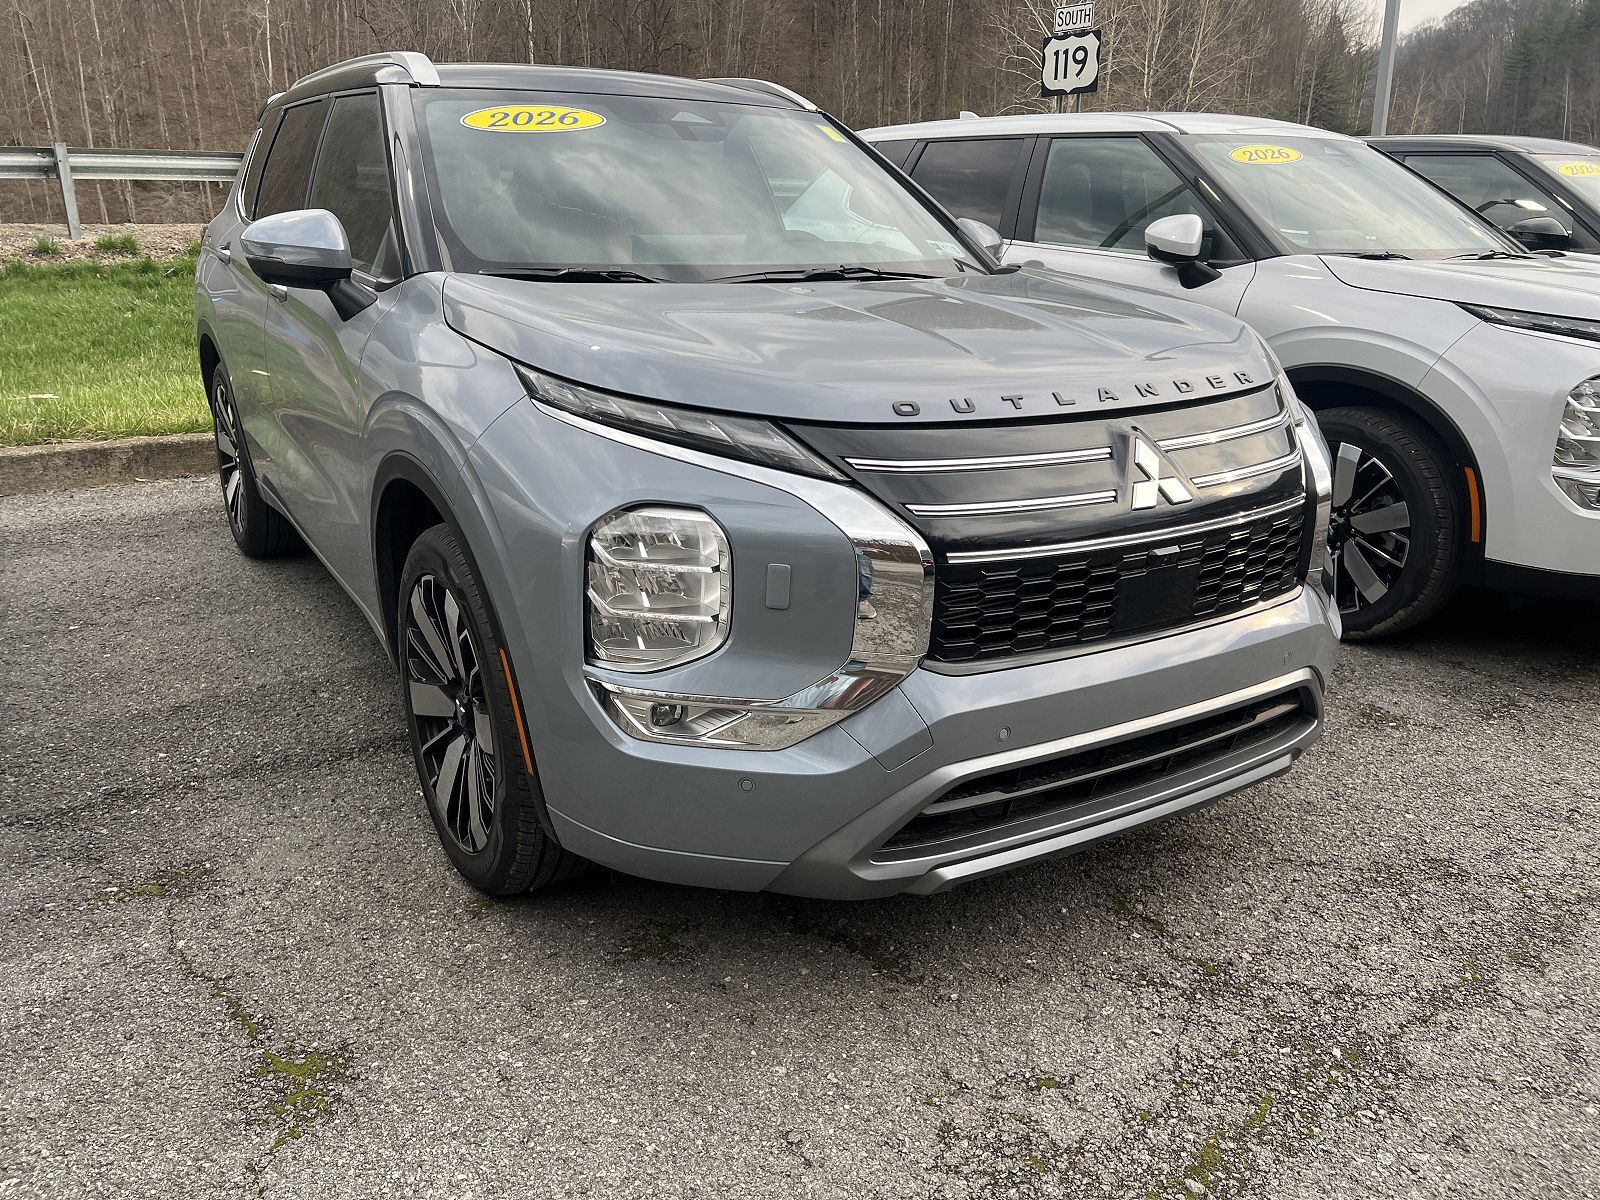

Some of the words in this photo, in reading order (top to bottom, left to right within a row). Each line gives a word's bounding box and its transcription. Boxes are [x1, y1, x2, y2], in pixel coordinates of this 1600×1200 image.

[1057, 8, 1091, 27] SOUTH
[1053, 45, 1088, 80] 119
[488, 111, 580, 127] 2026
[1242, 148, 1290, 161] 2026
[892, 370, 1254, 417] OUTLANDER
